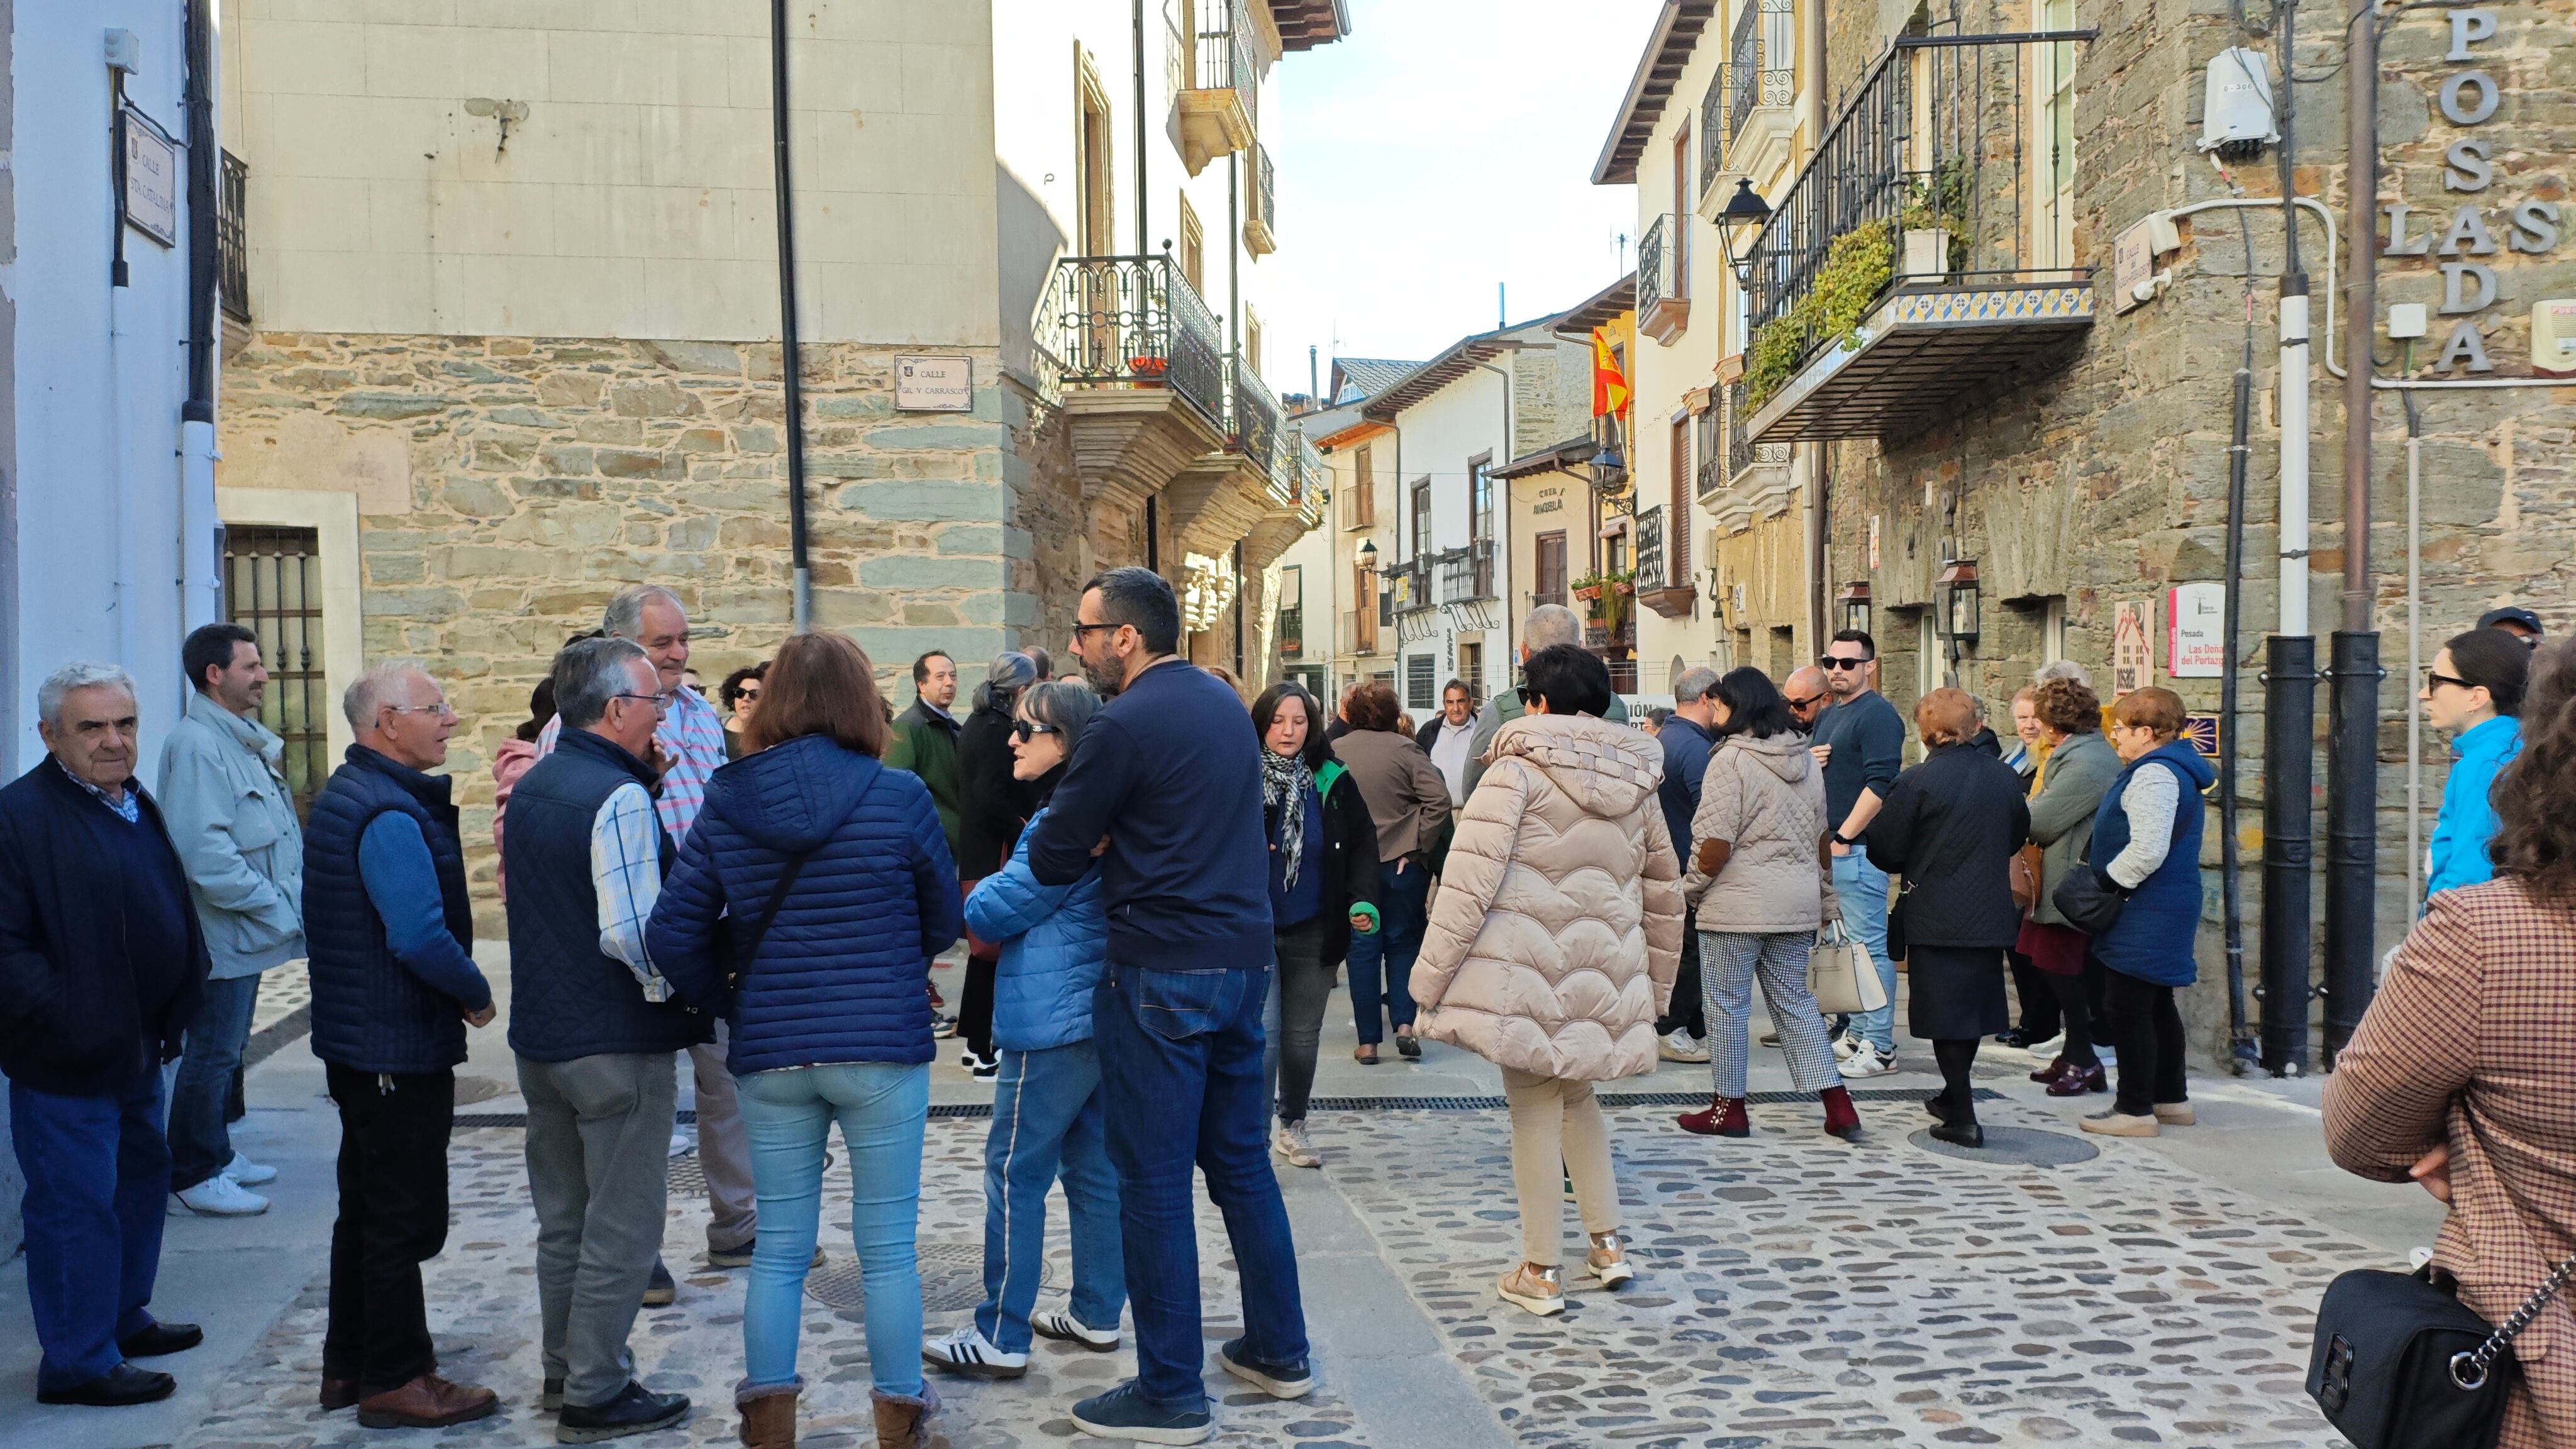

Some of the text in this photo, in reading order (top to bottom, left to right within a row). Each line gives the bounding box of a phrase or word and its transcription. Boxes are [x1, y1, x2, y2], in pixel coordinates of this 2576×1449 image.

[142, 155, 159, 175] CALLE
[2438, 8, 2499, 372] POSADA
[142, 185, 170, 214] CATALINA
[2180, 630, 2204, 638] Posada
[2189, 644, 2224, 654] Las Doña
[2181, 655, 2224, 667] del Portazg
